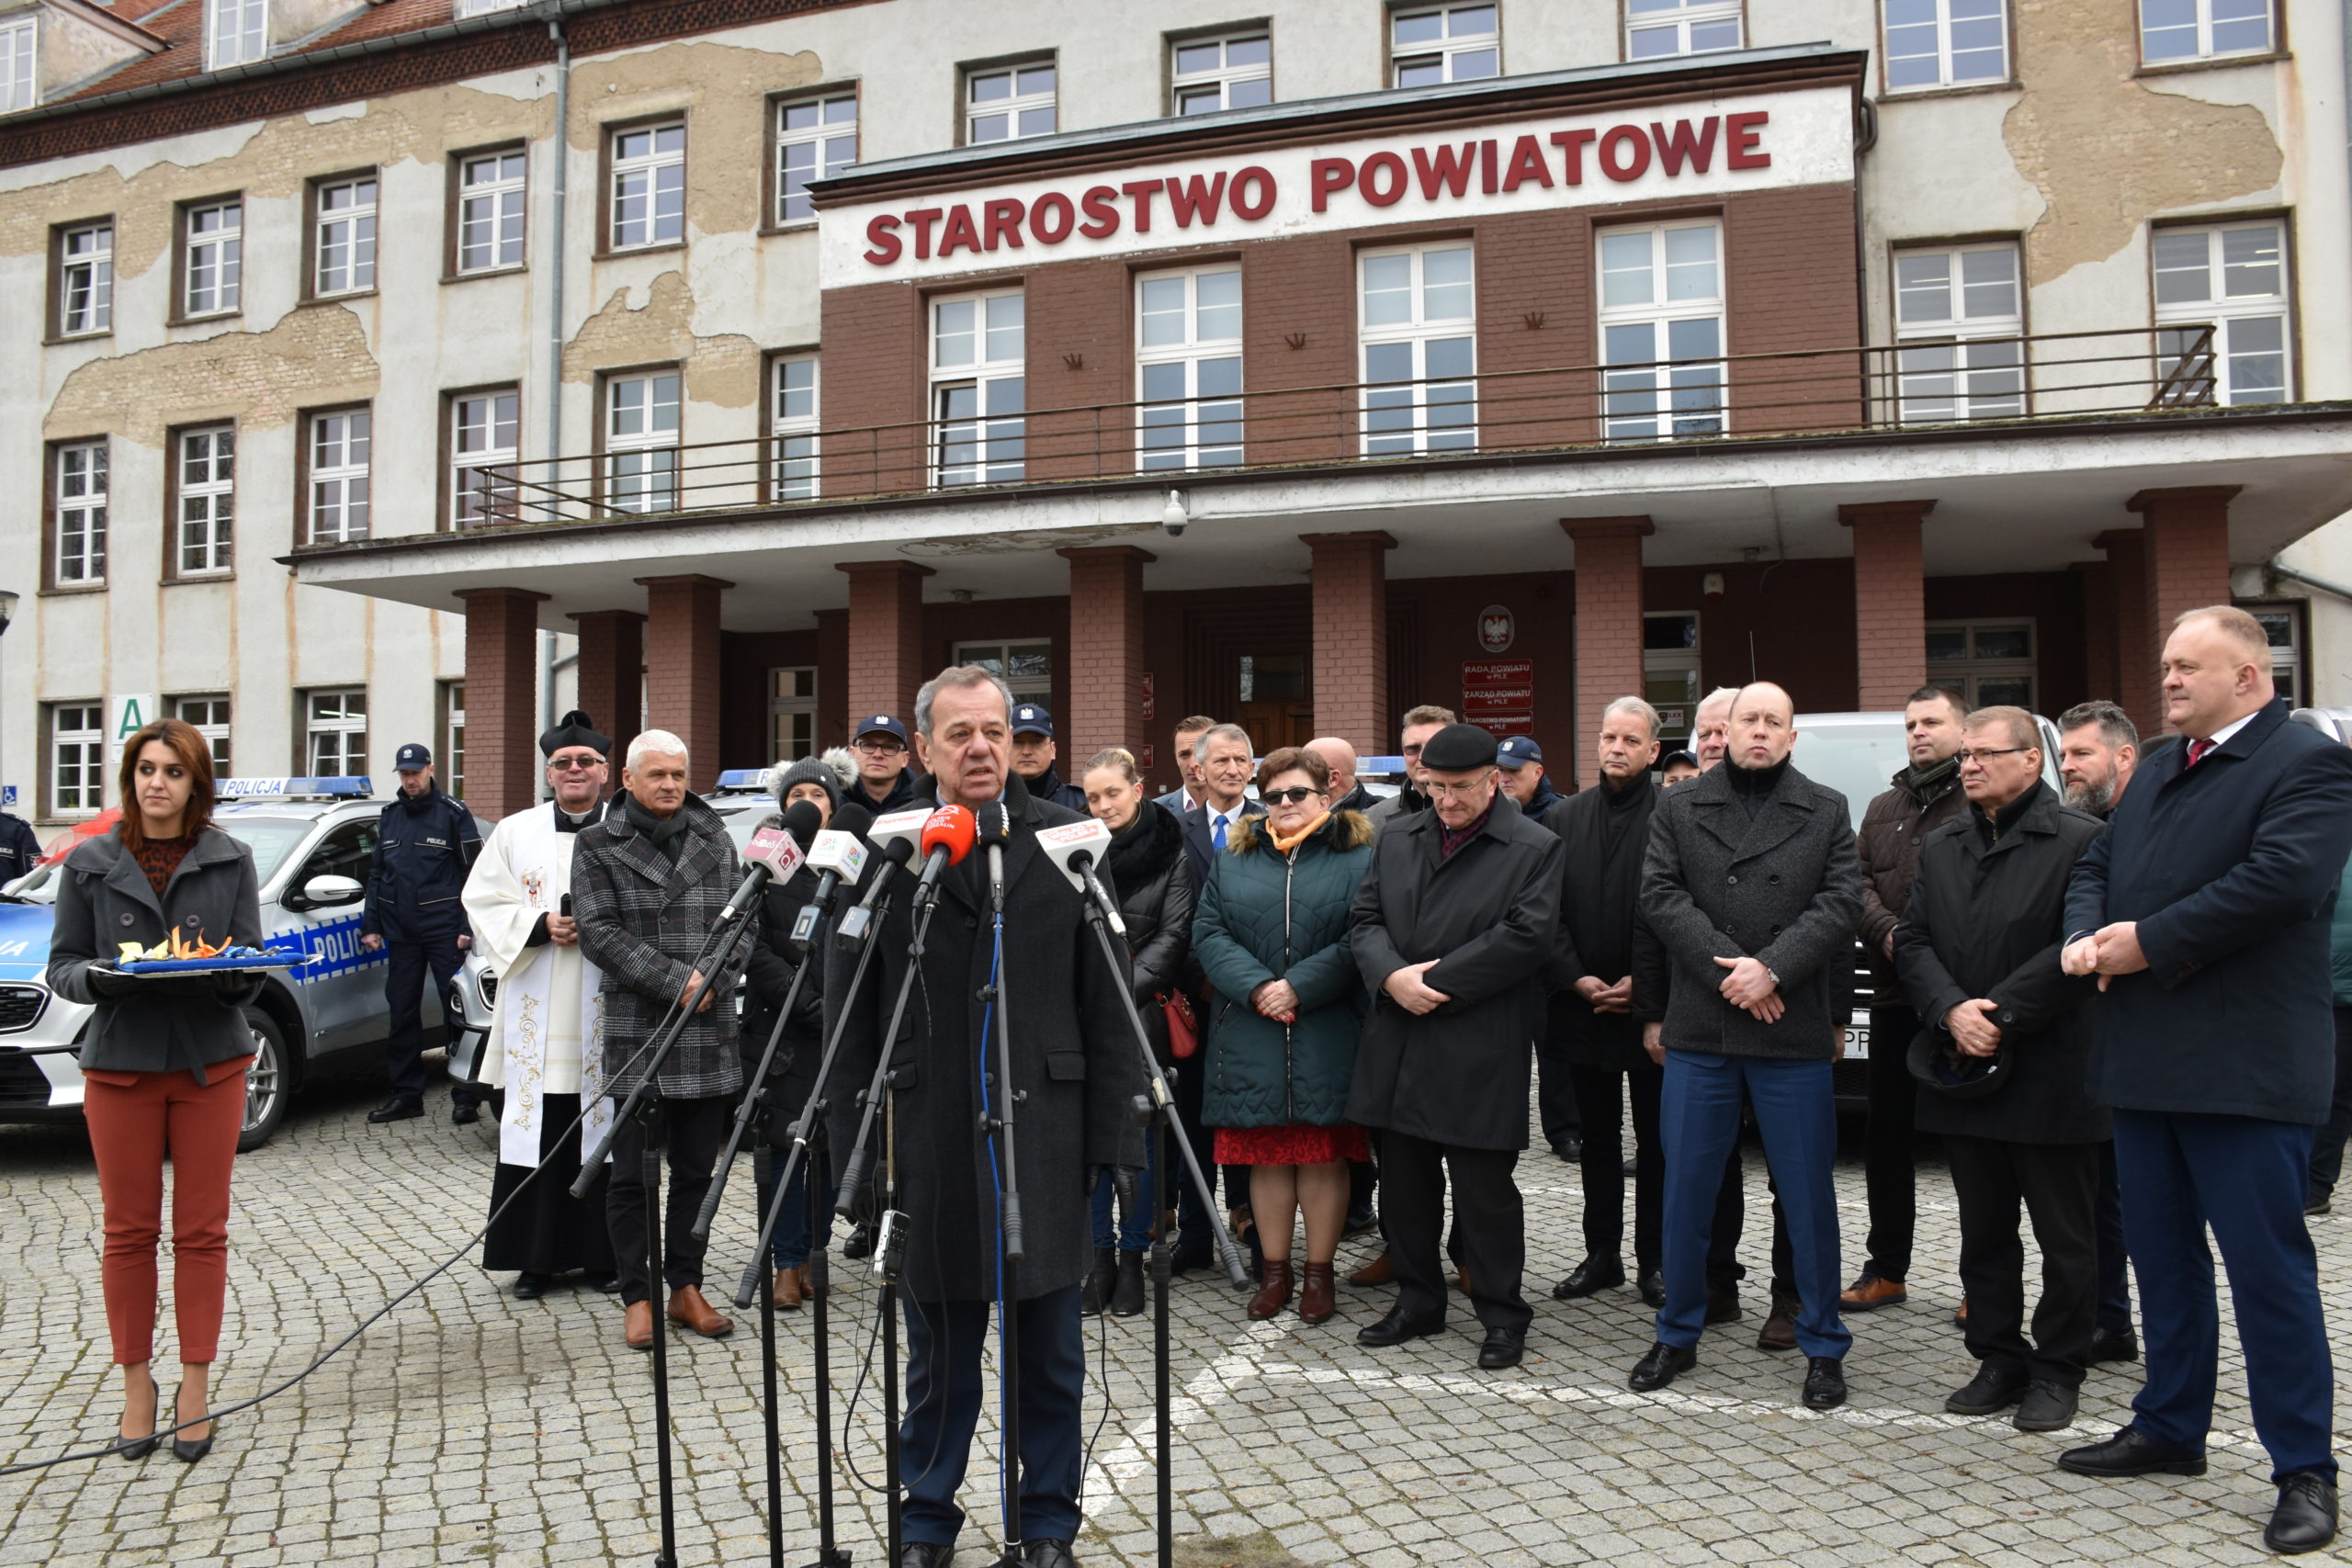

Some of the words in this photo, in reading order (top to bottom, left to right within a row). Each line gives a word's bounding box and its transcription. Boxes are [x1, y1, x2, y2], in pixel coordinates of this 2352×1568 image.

[865, 167, 1276, 265] STAROSTWO
[1312, 111, 1770, 211] POWIATOWE
[1491, 664, 1530, 672] POWIATU
[1464, 691, 1495, 699] ZARZĄD
[118, 698, 143, 739] A
[226, 781, 281, 795] POLICJA
[313, 928, 385, 966] POLIC
